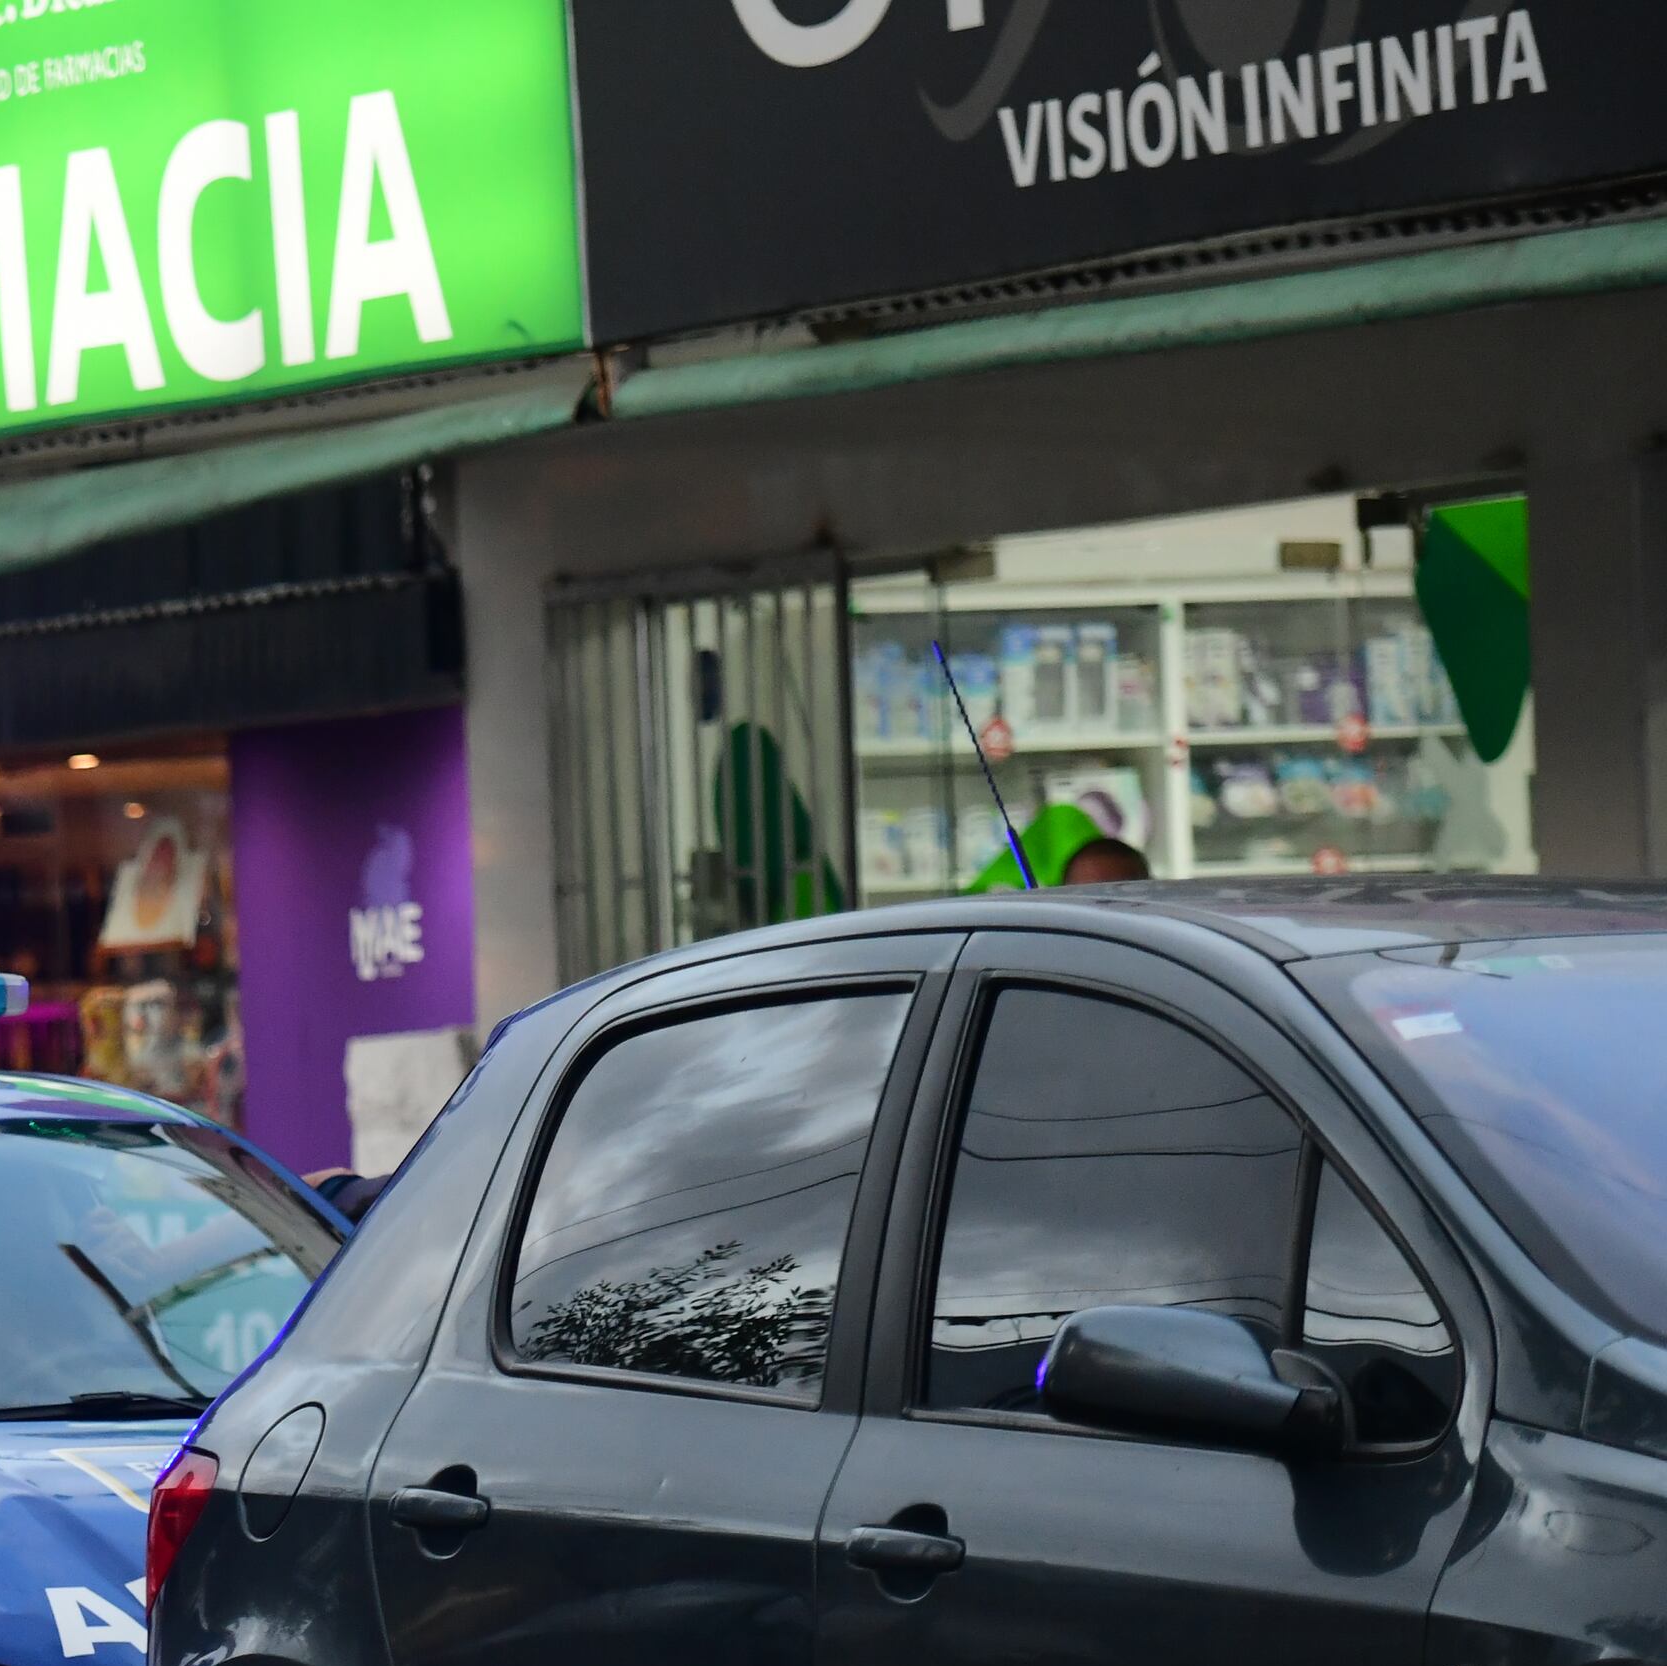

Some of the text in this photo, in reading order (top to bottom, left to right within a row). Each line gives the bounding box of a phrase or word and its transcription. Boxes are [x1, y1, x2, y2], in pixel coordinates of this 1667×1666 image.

[14, 61, 42, 97] DE
[43, 40, 147, 90] FARMACIAS
[998, 9, 1548, 188] VISIÓN INFINITA
